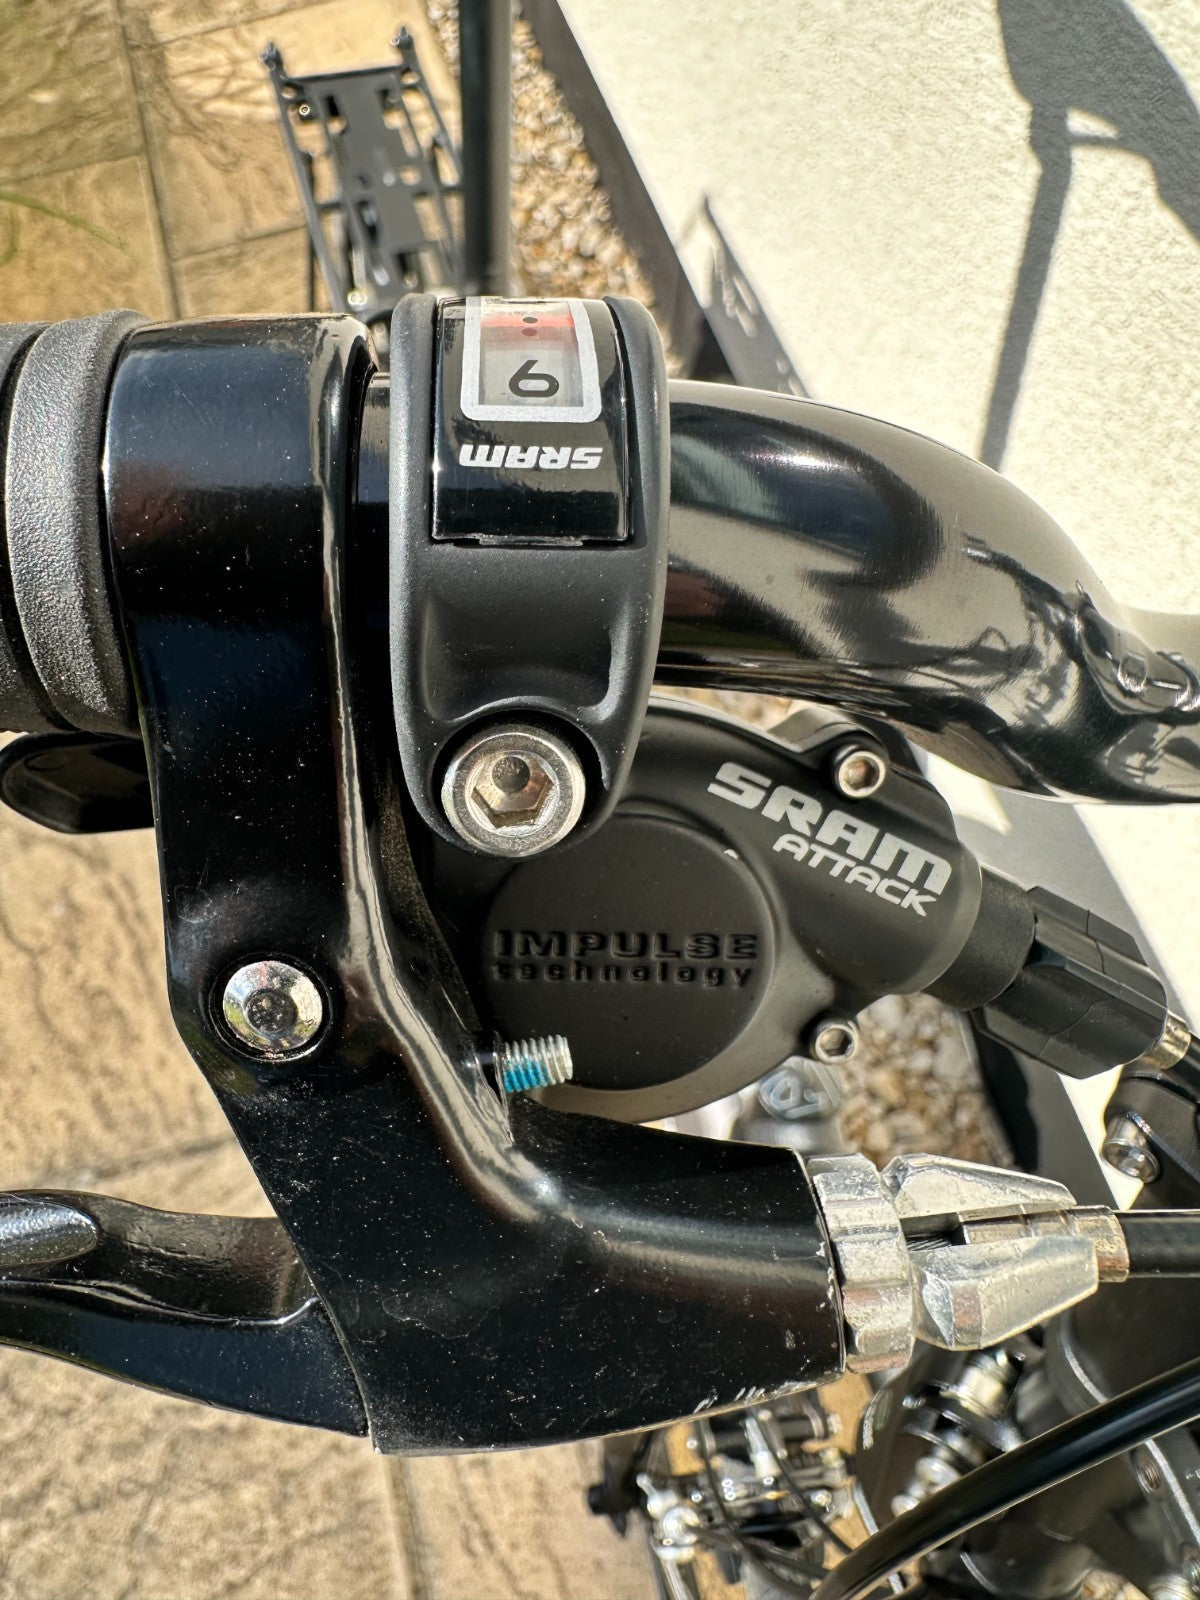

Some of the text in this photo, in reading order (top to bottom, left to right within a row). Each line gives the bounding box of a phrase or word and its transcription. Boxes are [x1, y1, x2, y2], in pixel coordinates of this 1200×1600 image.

[509, 360, 560, 398] 9
[459, 445, 603, 470] SRAM
[708, 762, 952, 894] SRAM
[773, 834, 937, 917] ATTACK
[494, 930, 758, 960] IMPULSE
[491, 960, 753, 988] technology
